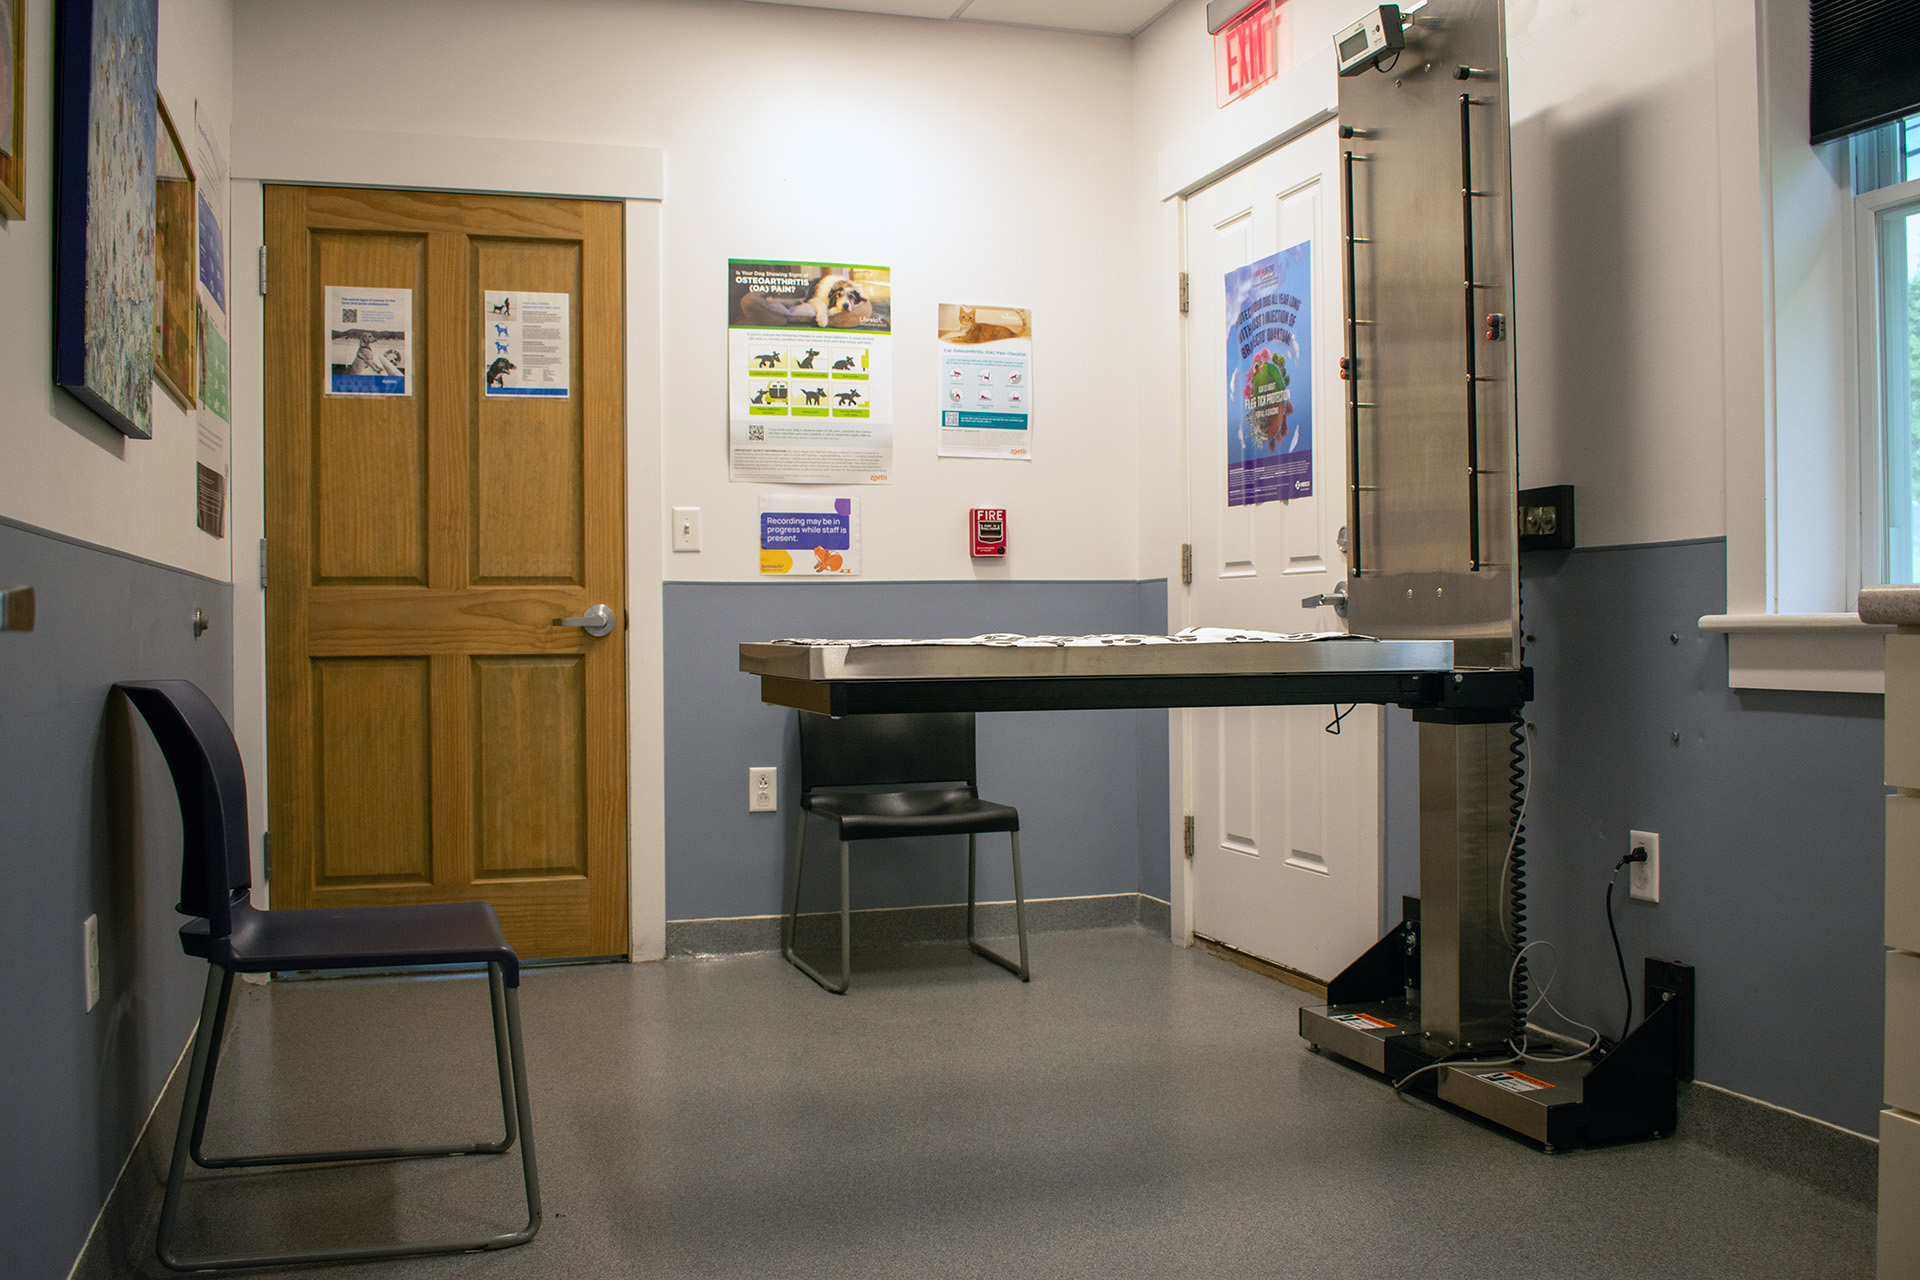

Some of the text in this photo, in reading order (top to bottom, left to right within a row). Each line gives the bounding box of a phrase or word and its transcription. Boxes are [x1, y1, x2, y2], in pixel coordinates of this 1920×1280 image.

[1226, 8, 1265, 95] EXIT
[736, 276, 810, 286] OSTEOARTHRITIS
[749, 285, 770, 293] (OA)
[1279, 294, 1289, 305] YEAR
[1265, 310, 1289, 324] INJECTION
[1289, 313, 1296, 328] OF
[978, 510, 1003, 520] FIRE
[767, 517, 805, 526] Recording
